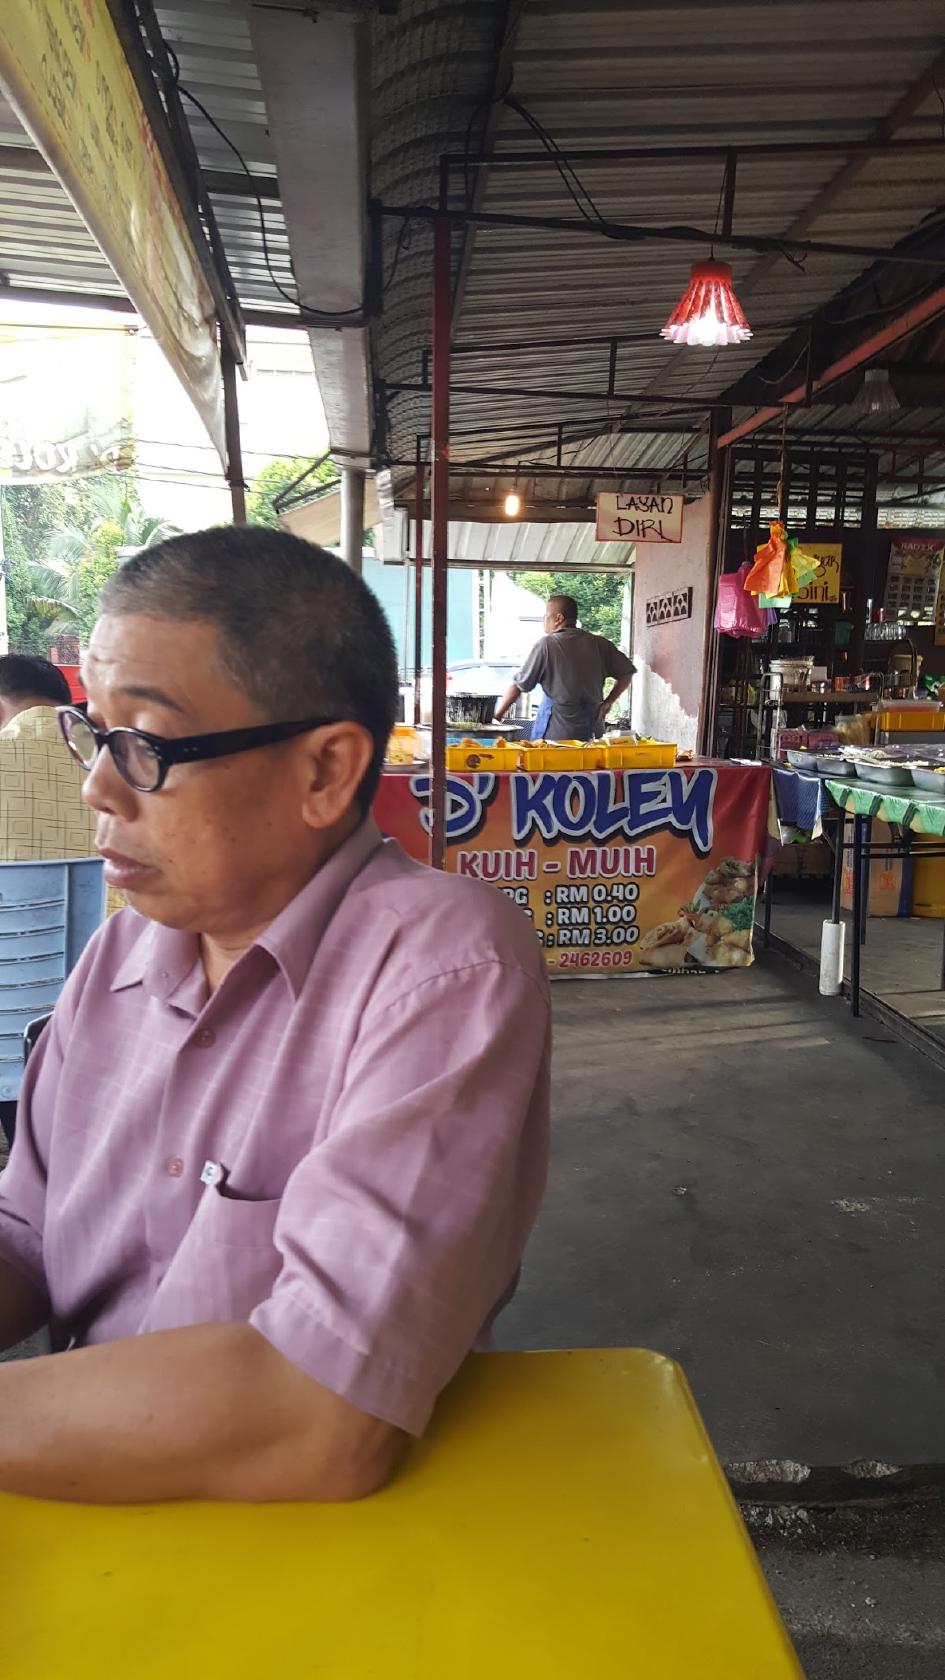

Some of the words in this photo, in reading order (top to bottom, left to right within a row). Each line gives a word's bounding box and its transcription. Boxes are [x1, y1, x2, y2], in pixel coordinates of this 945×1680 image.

[612, 517, 674, 541] DIRI
[458, 851, 537, 881] KUIH
[567, 846, 656, 878] MUIH
[592, 884, 640, 901] 0.40
[593, 905, 637, 923] 1.00
[594, 926, 640, 944] 3.00
[559, 950, 633, 968] 2462609
